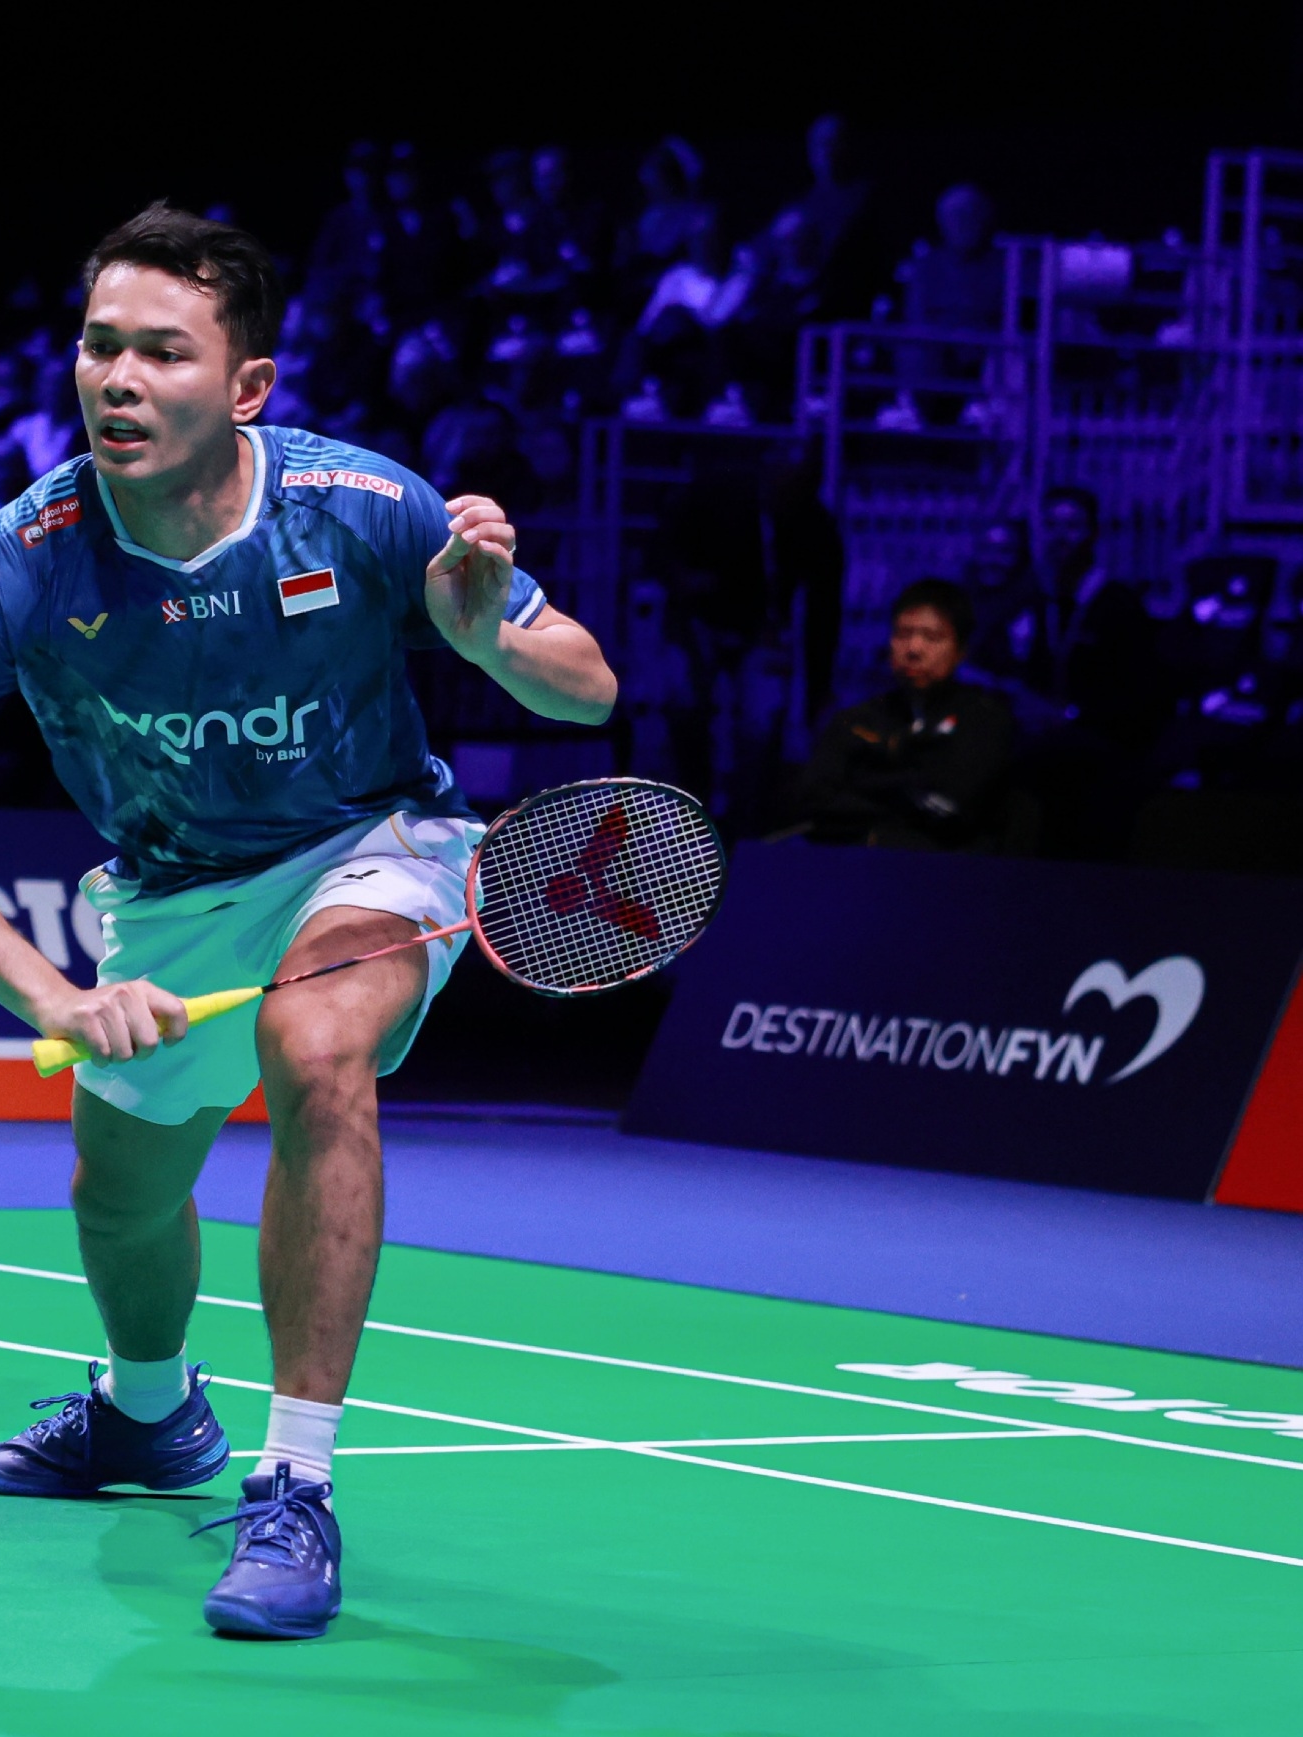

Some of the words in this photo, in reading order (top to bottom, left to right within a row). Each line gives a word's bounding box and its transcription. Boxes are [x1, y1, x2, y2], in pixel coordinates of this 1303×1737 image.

[191, 590, 242, 619] BNI
[98, 695, 319, 764] wondr
[256, 749, 274, 764] by
[277, 747, 306, 762] BNI
[722, 1003, 1104, 1085] DESTINATIONFYN
